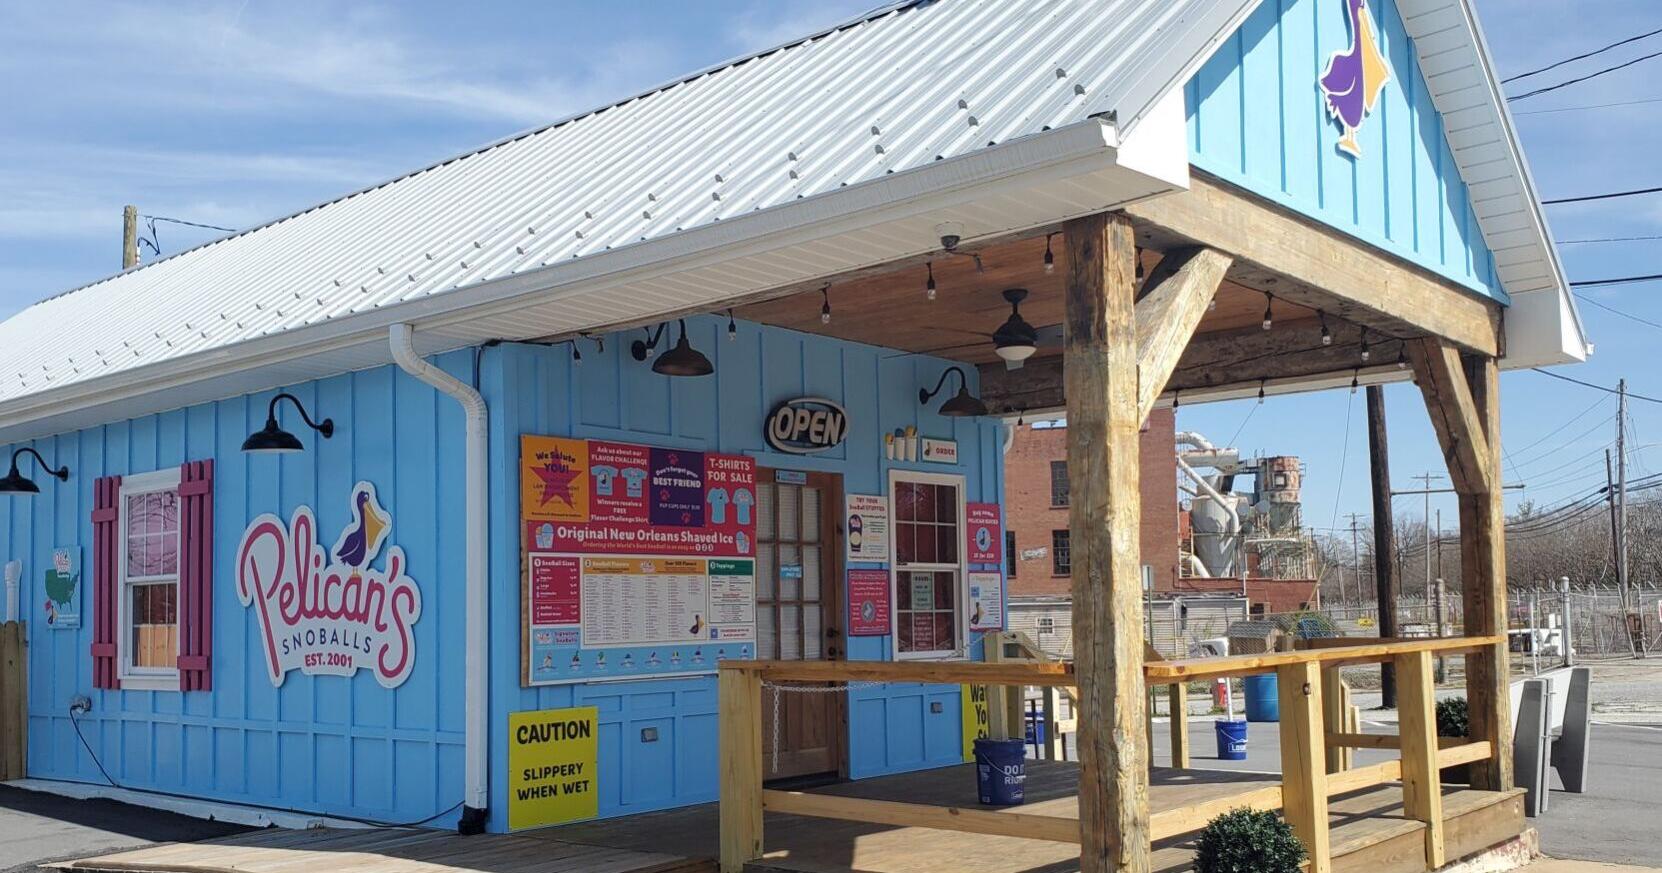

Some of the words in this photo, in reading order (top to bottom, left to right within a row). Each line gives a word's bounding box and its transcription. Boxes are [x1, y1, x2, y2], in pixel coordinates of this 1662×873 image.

[774, 406, 842, 445] OPEN
[536, 451, 549, 460] We
[550, 451, 576, 463] Salute
[935, 447, 955, 456] ORDER
[592, 454, 614, 462] FLAVOR
[615, 456, 647, 466] CHALLENGE
[709, 458, 750, 471] T-SHIRTS
[544, 463, 569, 473] YOU!
[653, 477, 672, 486] BEST
[673, 478, 701, 488] FRIEND
[707, 471, 726, 482] FOR
[731, 472, 753, 484] SALE
[597, 498, 619, 506] Winners
[609, 515, 635, 524] Challenge
[557, 526, 608, 542] Original
[610, 528, 635, 540] New
[637, 530, 679, 542] Orleans
[681, 531, 717, 543] Shaved
[720, 532, 733, 544] Ice
[240, 522, 415, 678] Pelican's
[282, 628, 372, 654] SNOBALLS
[304, 653, 326, 667] EST.
[327, 653, 353, 668] 2001
[970, 683, 985, 702] Wa
[975, 704, 986, 725] Yo
[517, 720, 591, 745] CAUTION
[523, 762, 584, 781] SLIPPERY
[517, 784, 558, 801] WHEN
[562, 780, 590, 795] WET
